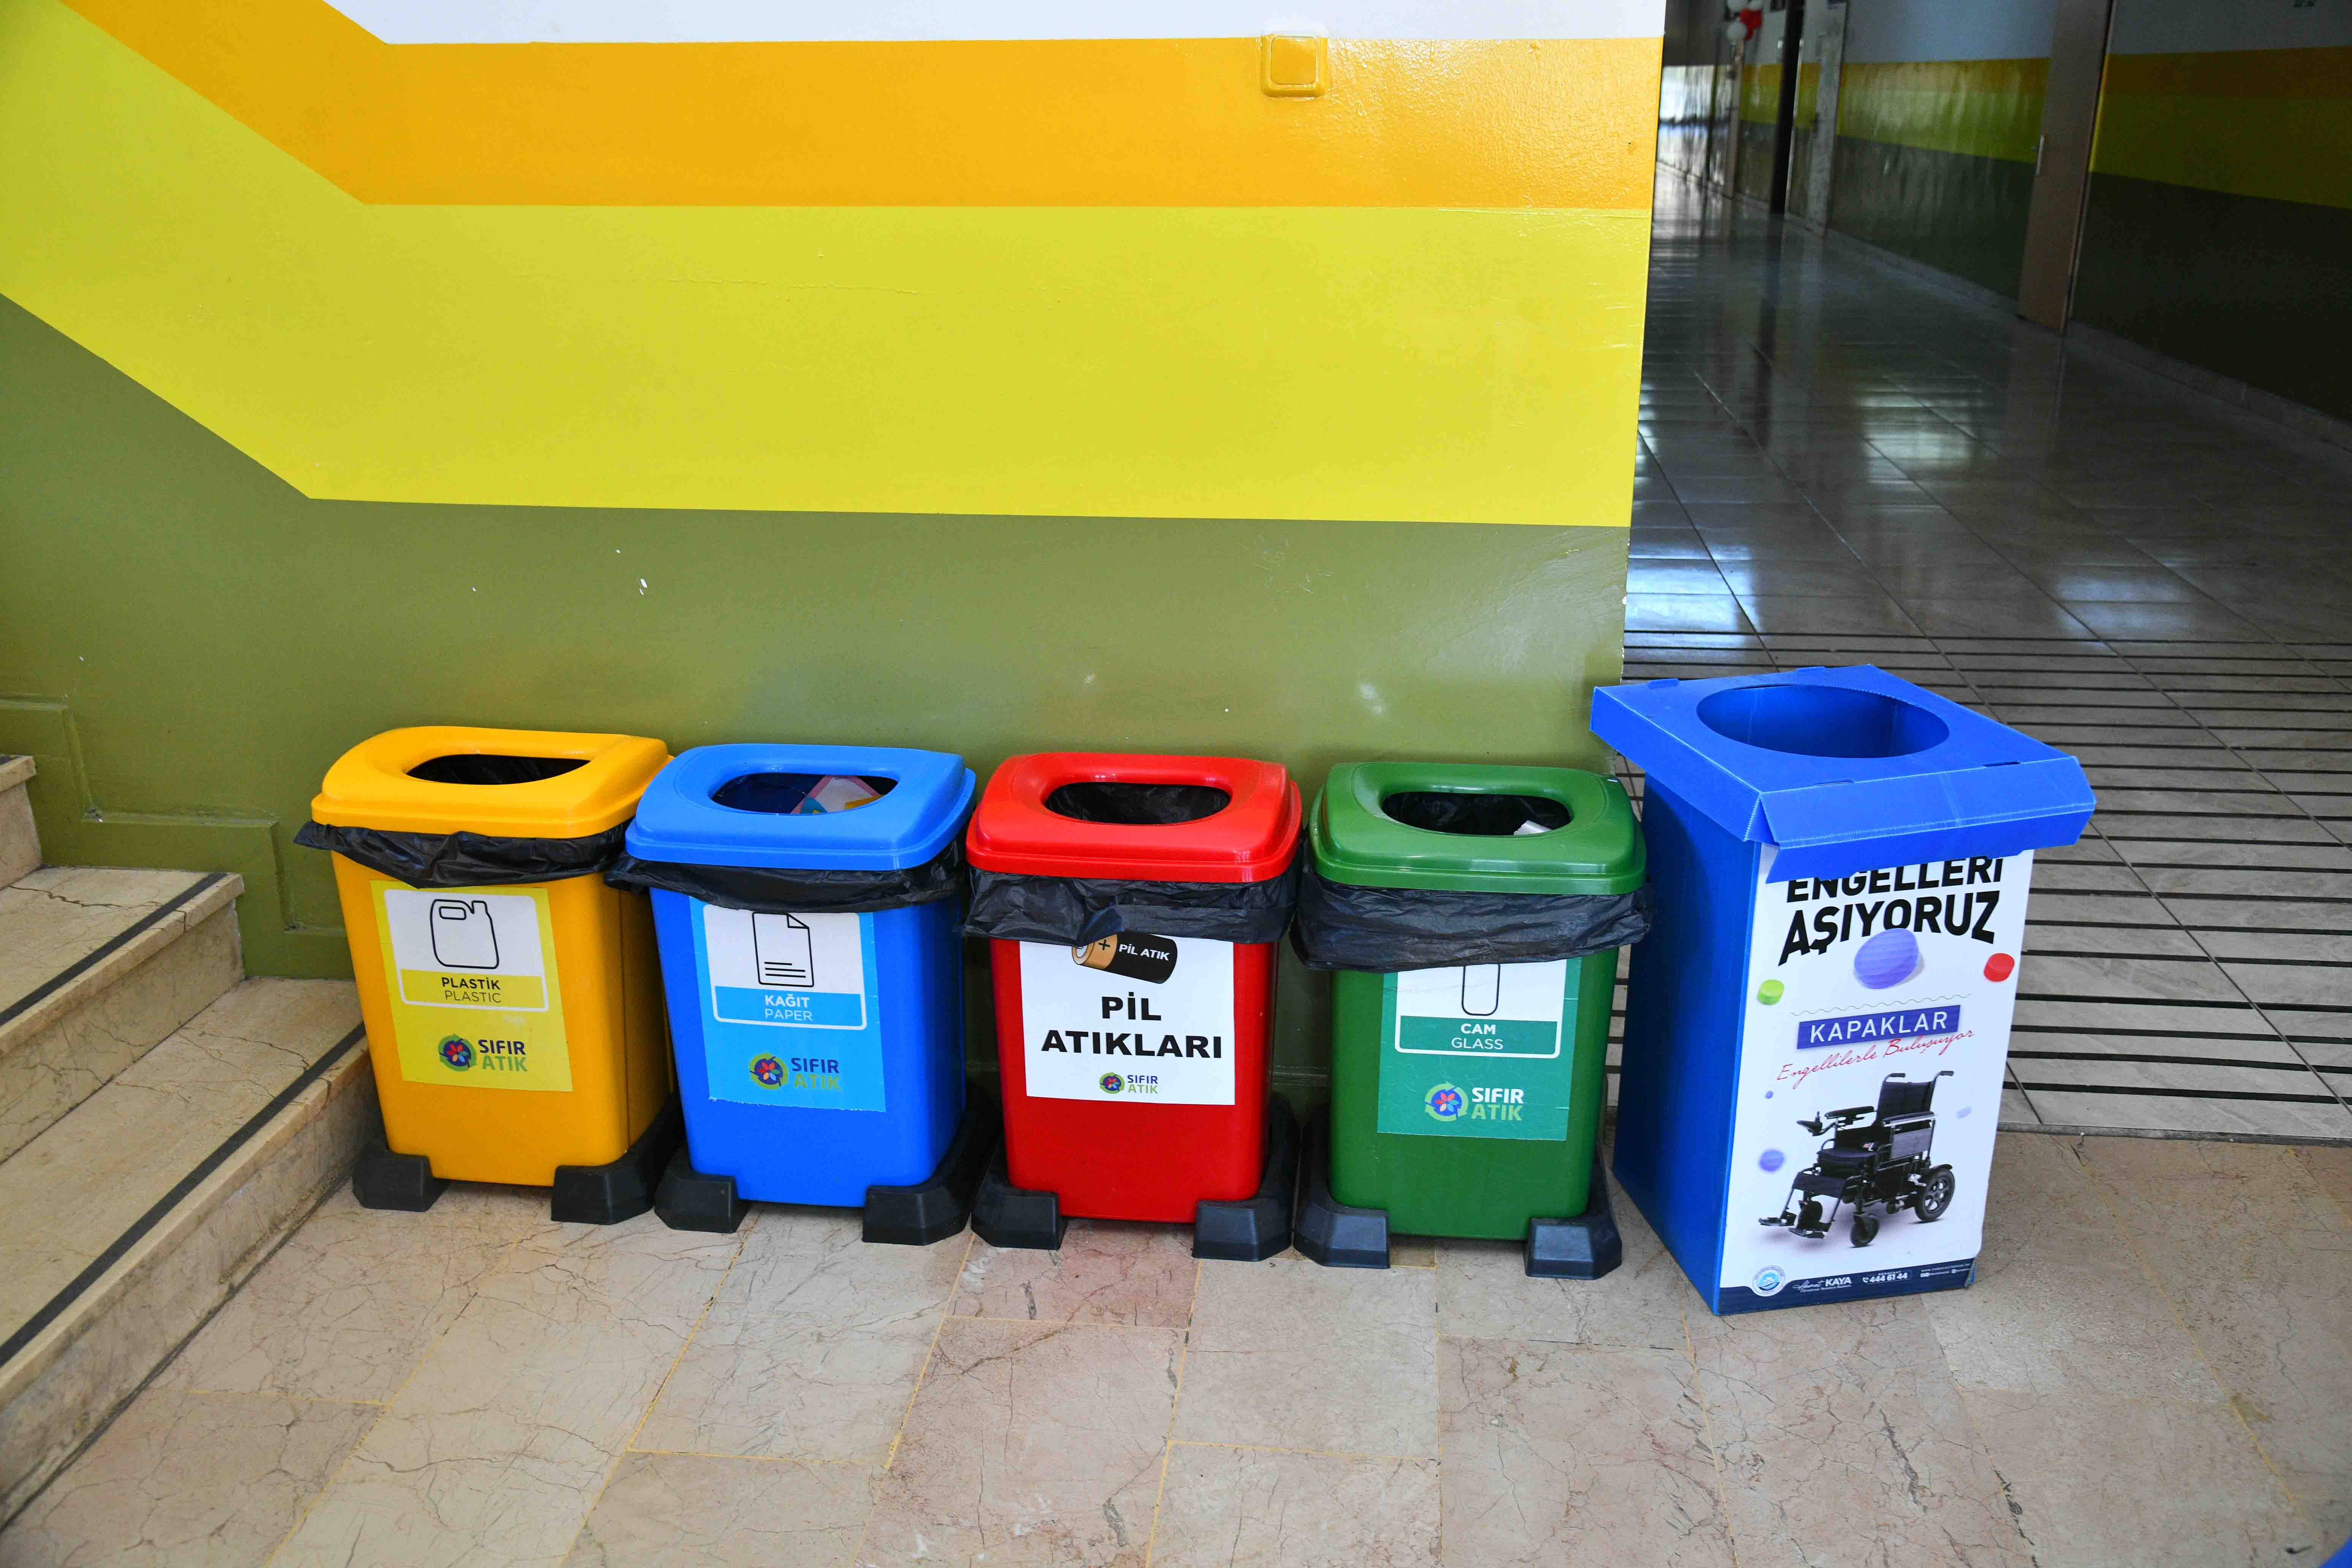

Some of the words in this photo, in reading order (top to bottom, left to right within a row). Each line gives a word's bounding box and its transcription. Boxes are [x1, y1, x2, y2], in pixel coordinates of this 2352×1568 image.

[1778, 891, 2000, 966] AŞIYORUZ
[1119, 944, 1138, 955] PİL
[1140, 948, 1170, 961] ATIK
[441, 977, 501, 990] PLASTİK
[444, 990, 501, 1003] PLASTIC
[765, 994, 810, 1008] KAĞIT
[765, 1008, 813, 1021] PAPER
[1102, 992, 1161, 1021] PİL
[1461, 1023, 1496, 1035] CAM
[1810, 1011, 1947, 1043] KAPAKLAR
[478, 1039, 526, 1055] SIFIR
[1042, 1030, 1221, 1058] ATIKLARI
[1451, 1037, 1503, 1050] GLASS
[482, 1055, 528, 1072] ATIK
[791, 1057, 839, 1073] SIFIR
[1777, 1045, 1878, 1089] Engellilerle
[1883, 1030, 1975, 1057] Buluşuyor
[794, 1073, 841, 1090] ATIK
[1127, 1075, 1158, 1084] SIFIR
[1128, 1084, 1158, 1094] ATIK
[1472, 1087, 1524, 1104] SIFIR
[1471, 1103, 1523, 1121] ATIK
[1825, 1277, 1852, 1287] KAYA
